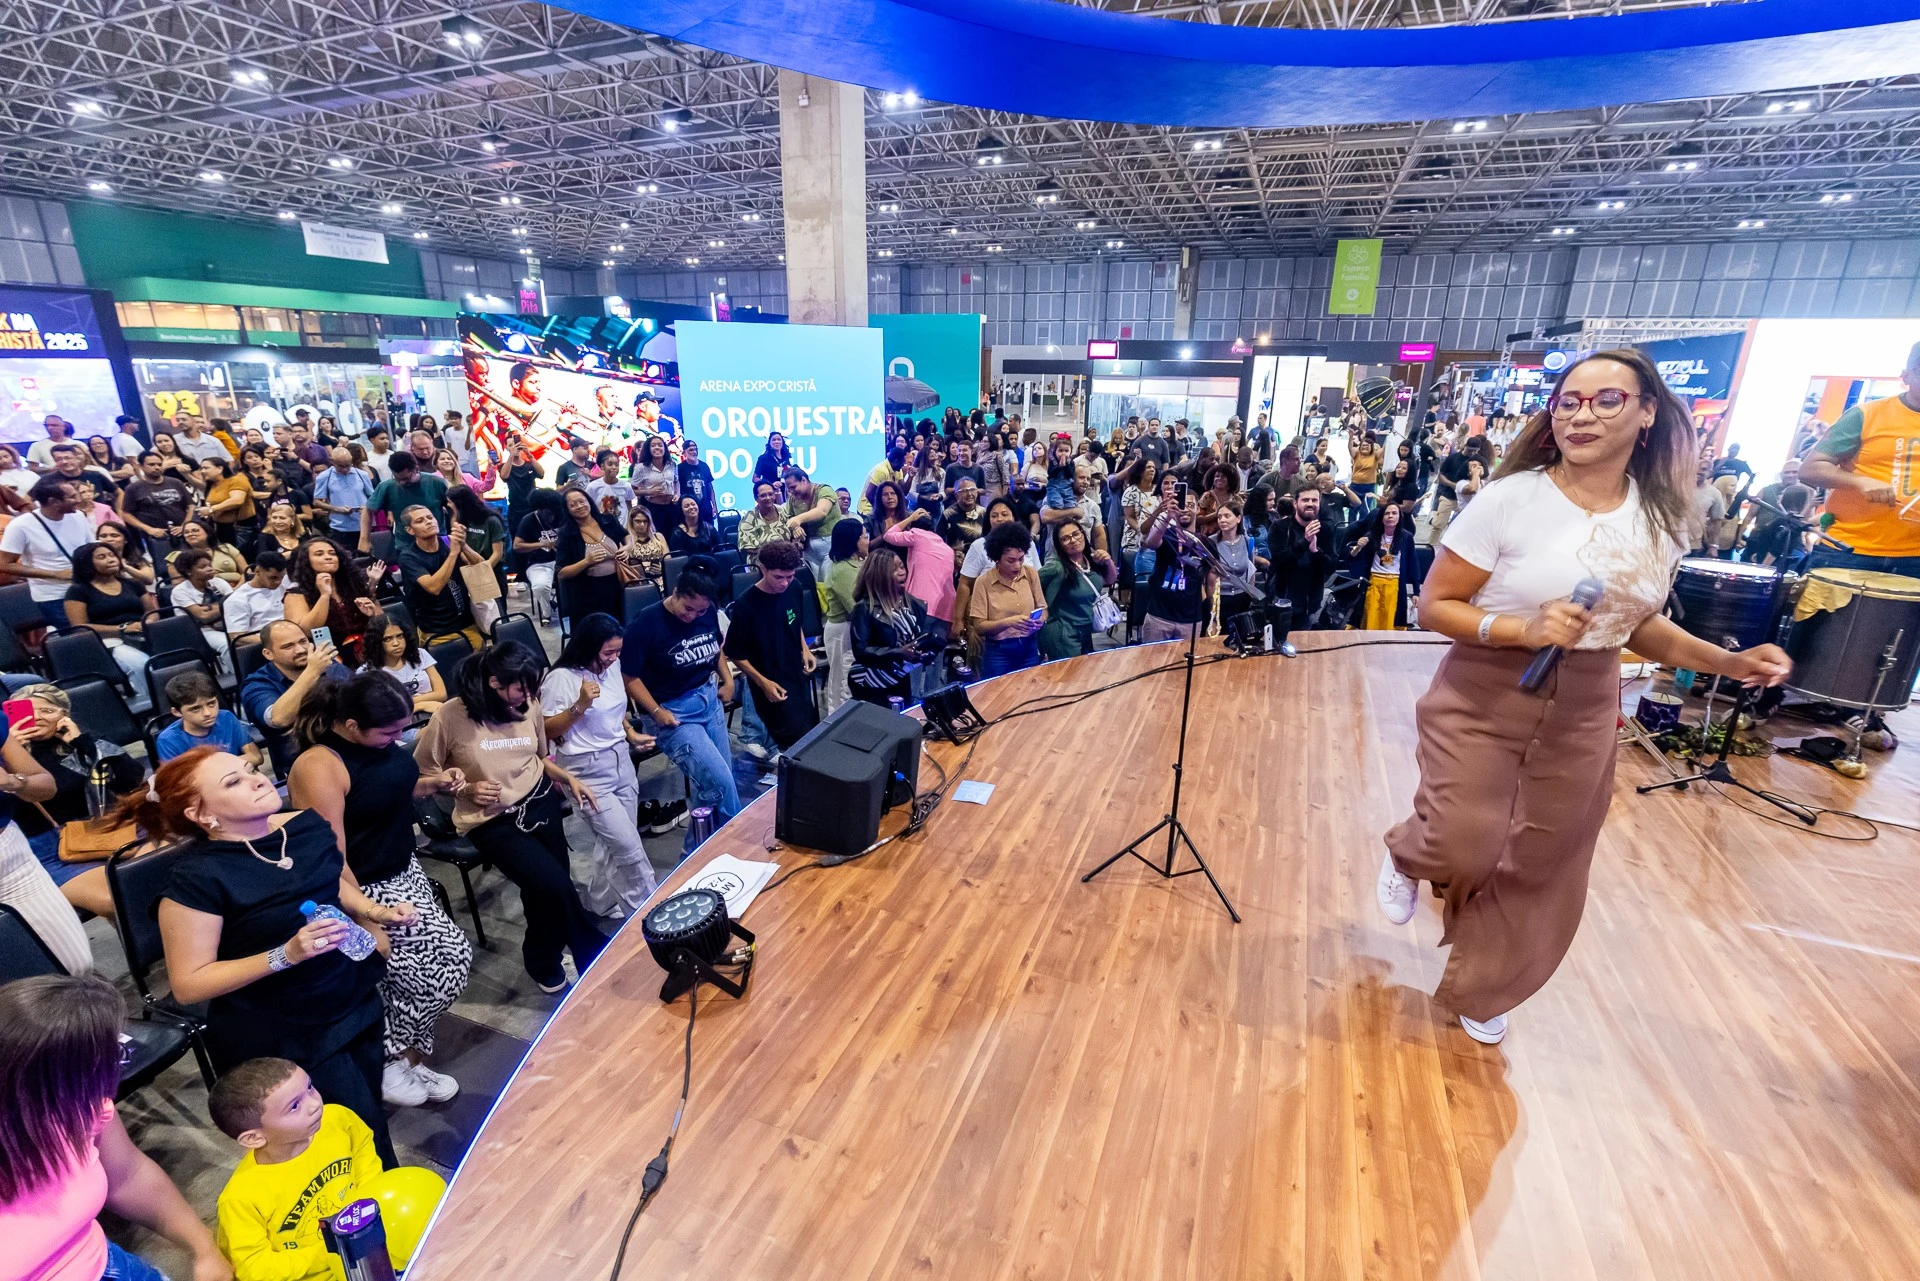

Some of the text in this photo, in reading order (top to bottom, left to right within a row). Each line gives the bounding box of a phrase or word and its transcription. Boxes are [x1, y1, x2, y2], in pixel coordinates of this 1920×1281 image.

[520, 300, 539, 314] Pita
[10, 312, 39, 331] NA
[44, 332, 89, 350] 2025
[700, 378, 817, 392] ARENA EXPO CRISTÃ
[154, 390, 200, 419] 93
[701, 405, 886, 439] ORQUESTRA
[706, 448, 754, 480] DO
[284, 1159, 352, 1227] TEAM WOR
[283, 1241, 299, 1250] 19
